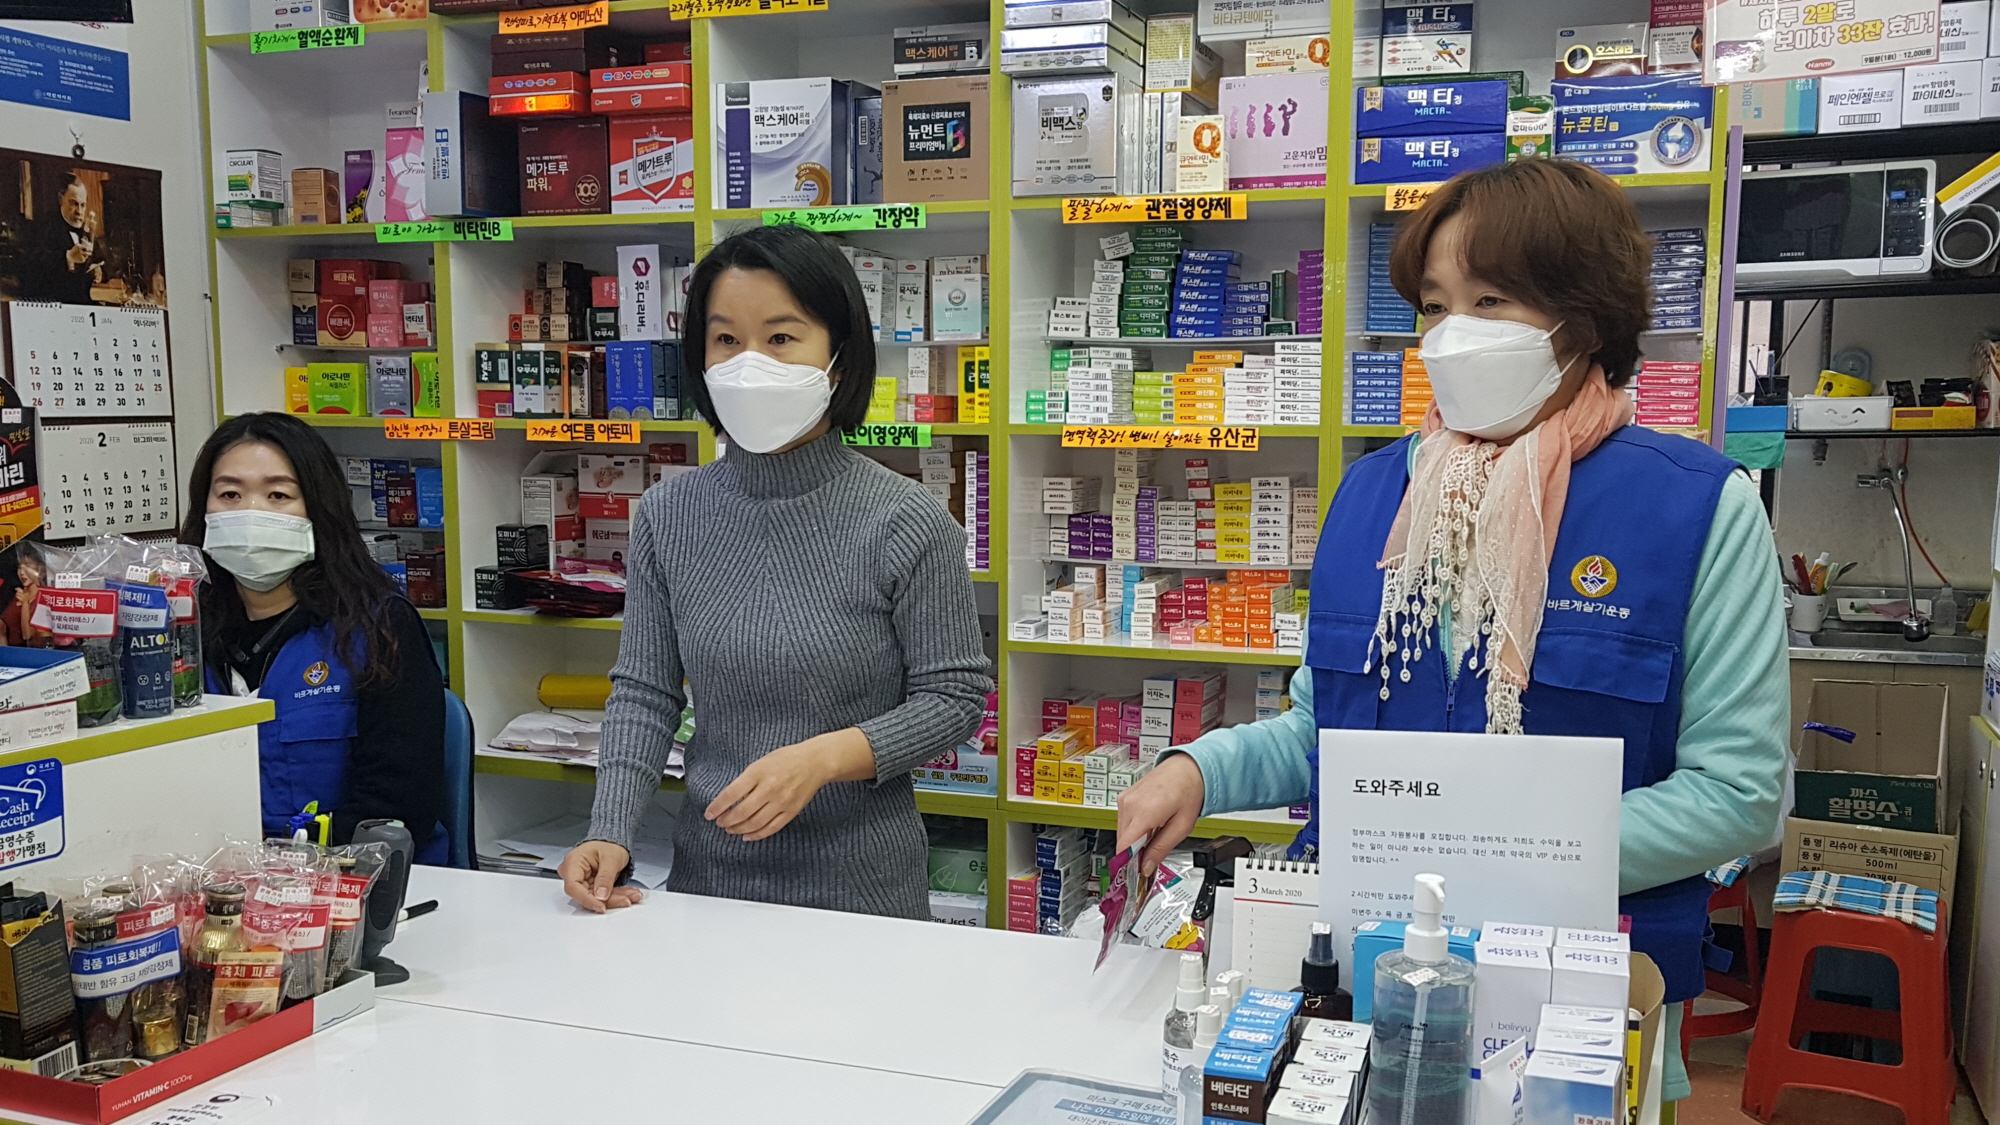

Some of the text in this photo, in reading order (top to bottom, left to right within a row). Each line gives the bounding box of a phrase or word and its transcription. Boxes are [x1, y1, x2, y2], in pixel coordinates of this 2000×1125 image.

[570, 7, 602, 26] 아미노산
[1759, 6, 1798, 30] 하루
[298, 27, 359, 48] 혈액순환제
[1774, 11, 1935, 52] 보이차 33잔 효과!
[905, 46, 949, 60] 맥스케어
[1807, 58, 1834, 69] Hanmi
[1408, 89, 1427, 106] 맥
[1827, 93, 1873, 106] 페인엔젤
[754, 112, 799, 127] 맥스케어
[1414, 107, 1446, 116] MACTA
[908, 123, 945, 140] 뉴먼트
[1561, 115, 1609, 133] 뉴콘틴
[1405, 141, 1425, 158] 맥
[526, 161, 570, 176] 메가트루
[638, 151, 674, 173] 메가트루
[1412, 159, 1443, 167] MACTA
[526, 177, 548, 192] 파워
[577, 183, 600, 197] 100
[1145, 197, 1231, 219] 관절영양제
[873, 207, 919, 228] 간장약
[454, 222, 501, 240] 비타민B
[89, 312, 97, 327] 1
[30, 367, 40, 375] 12
[52, 367, 61, 375] 13
[74, 368, 83, 376] 14
[94, 368, 103, 376] 15
[153, 369, 160, 377] 18
[447, 422, 494, 439] 튼살크림
[561, 423, 595, 437] 여드름
[598, 423, 633, 441] 아토피
[840, 425, 918, 446] 이영양제
[1207, 427, 1257, 448] 유산균
[97, 432, 107, 447] 2
[1547, 598, 1631, 620] 바르게살기운동
[1352, 778, 1442, 798] 도와주세요
[1849, 787, 1879, 799] 까스
[0, 797, 29, 816] Cash
[1829, 797, 1899, 822] 활명수
[0, 811, 35, 828] eceipt
[1352, 828, 1386, 837] 정부마스크
[1391, 830, 1425, 840] 자원봉사를
[1431, 832, 1468, 842] 모집합니다.
[1472, 834, 1508, 844] 죄송하게도
[1513, 836, 1535, 845] 저희도
[1540, 838, 1561, 847] 수익을
[1352, 842, 1365, 850] 하는
[1370, 843, 1383, 851] 일이
[1387, 844, 1408, 852] 아니라
[1412, 846, 1434, 854] 보수는
[1438, 846, 1468, 855] 없습니다.
[1472, 848, 1487, 856] 대신
[1491, 849, 1506, 857] 저희
[1510, 851, 1532, 859] 약국의
[1552, 853, 1581, 861] 손님으로
[1829, 840, 1858, 851] 리슈아
[1860, 844, 1937, 861] 손소독제(에탄올)
[1352, 855, 1388, 864] 임명합니다.
[1865, 859, 1898, 870] 500ml
[1248, 877, 1302, 897] 3 March 2020
[1357, 891, 1384, 900] 시간씩만
[1351, 908, 1371, 917] 이번주
[83, 941, 161, 971] 명품 피로회복제!!
[251, 965, 275, 978] 피로
[100, 976, 117, 989] 함유
[121, 972, 136, 984] 고급
[1498, 1021, 1531, 1033] belivyu
[1211, 1081, 1250, 1099] 베타딘
[111, 1098, 132, 1111] YUHAN
[1086, 1093, 1172, 1115] 마스크 구매 5부제
[1210, 1102, 1250, 1115] 인후스프레이
[1070, 1102, 1151, 1124] 나는 어느 요일에
